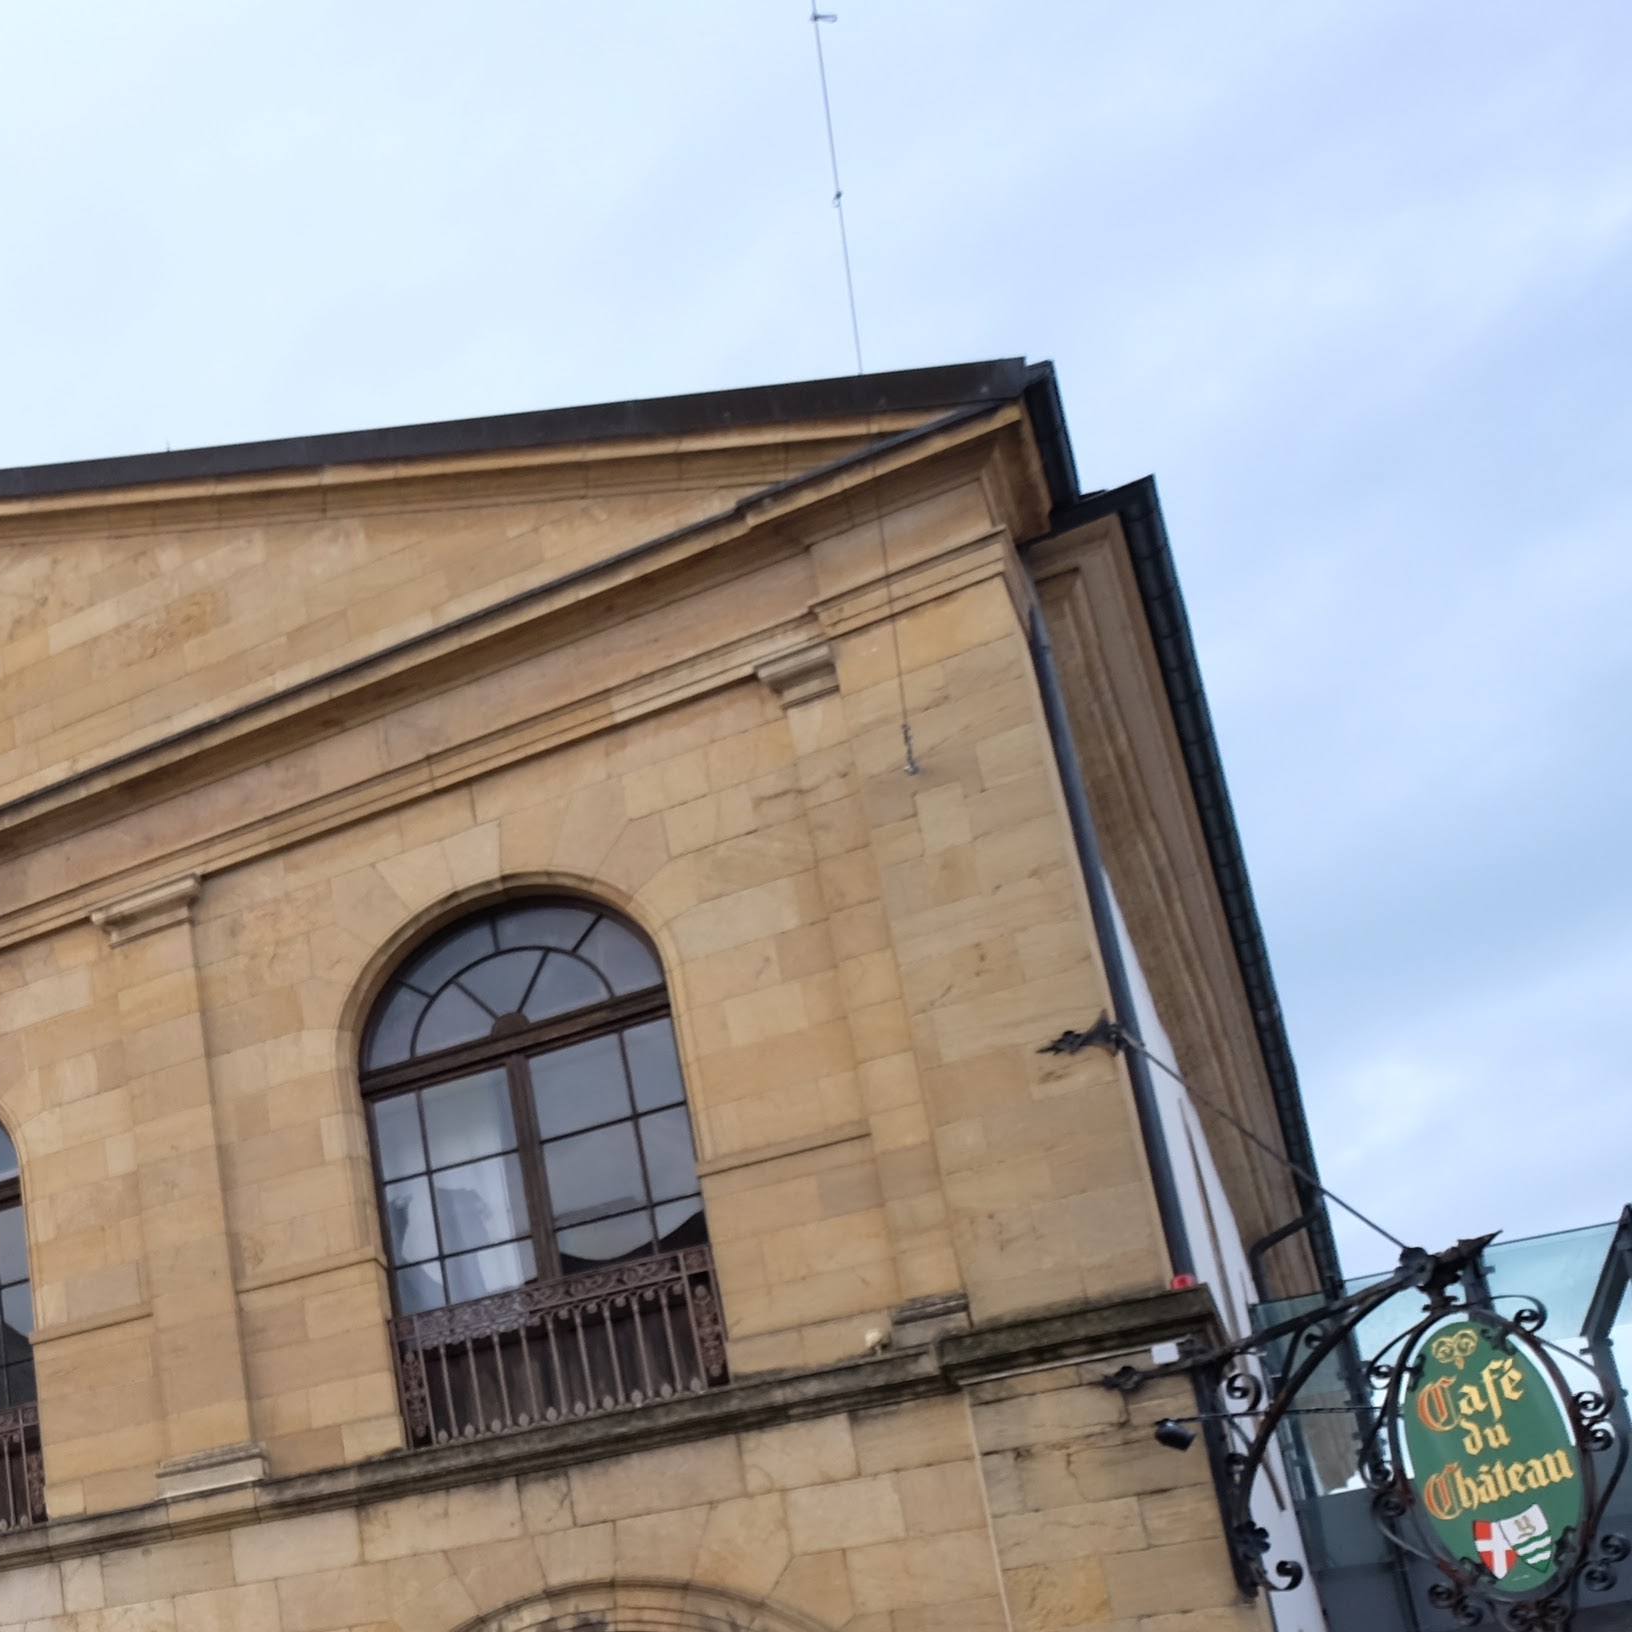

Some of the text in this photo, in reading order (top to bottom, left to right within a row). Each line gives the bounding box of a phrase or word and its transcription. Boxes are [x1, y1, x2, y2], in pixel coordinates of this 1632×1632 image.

[1417, 1358, 1524, 1432] Café
[1460, 1417, 1511, 1456] du
[1424, 1449, 1575, 1521] Château
